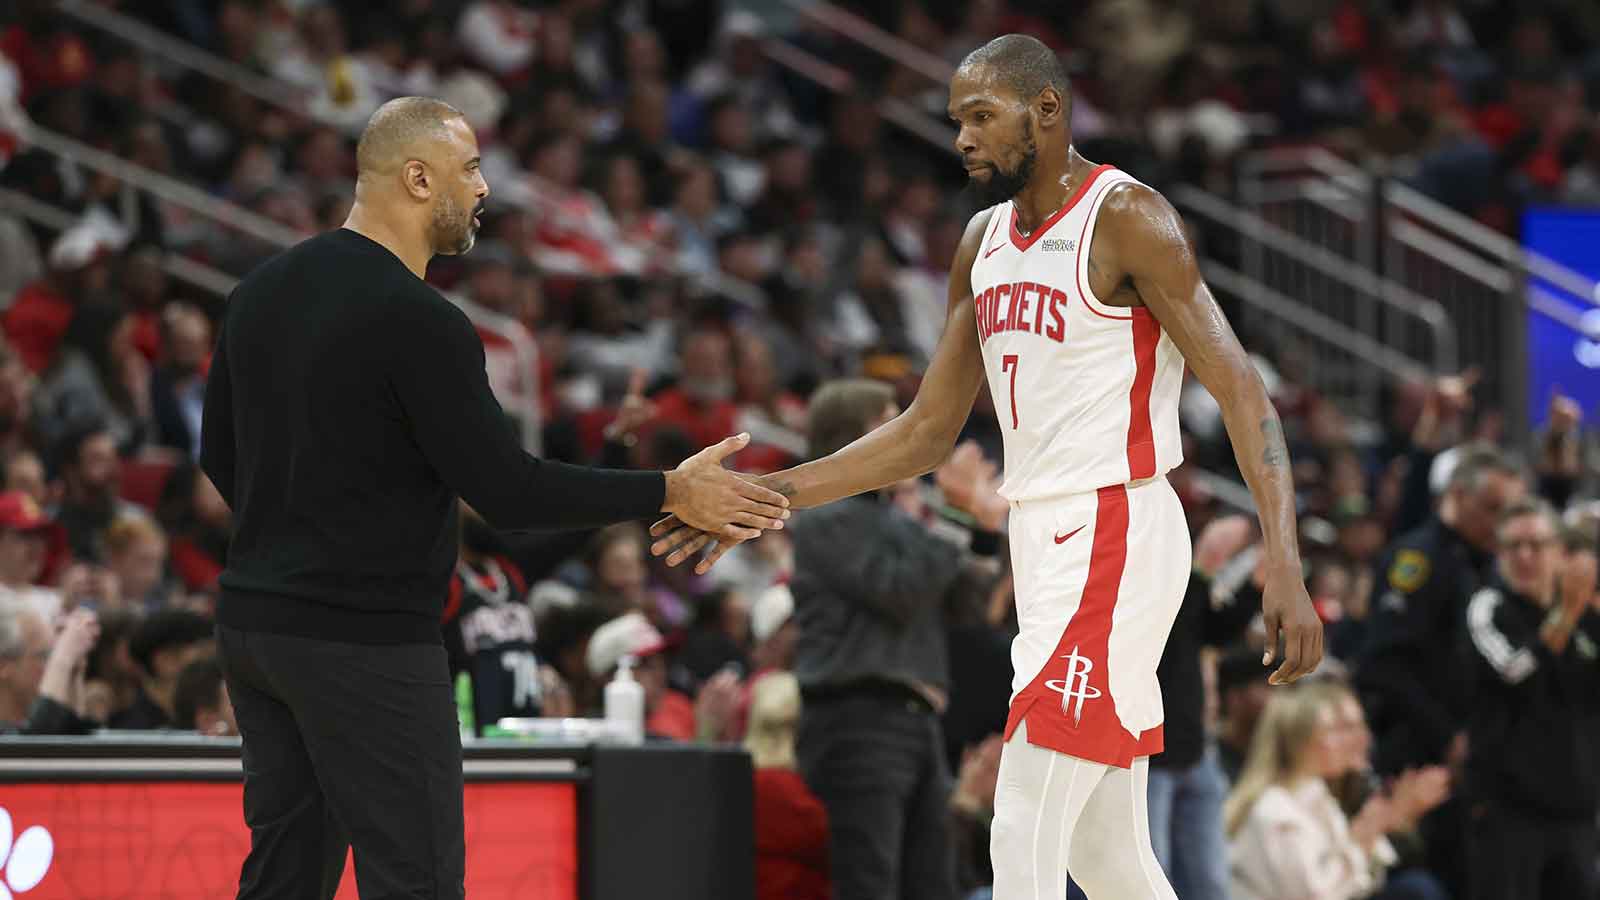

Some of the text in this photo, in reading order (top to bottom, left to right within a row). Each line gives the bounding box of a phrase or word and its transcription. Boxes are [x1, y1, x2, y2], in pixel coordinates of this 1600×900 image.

[1041, 239, 1075, 247] MEMORIAL
[1041, 245, 1075, 253] HERMANN
[975, 281, 1068, 346] ROCKETS
[1002, 355, 1019, 430] 7
